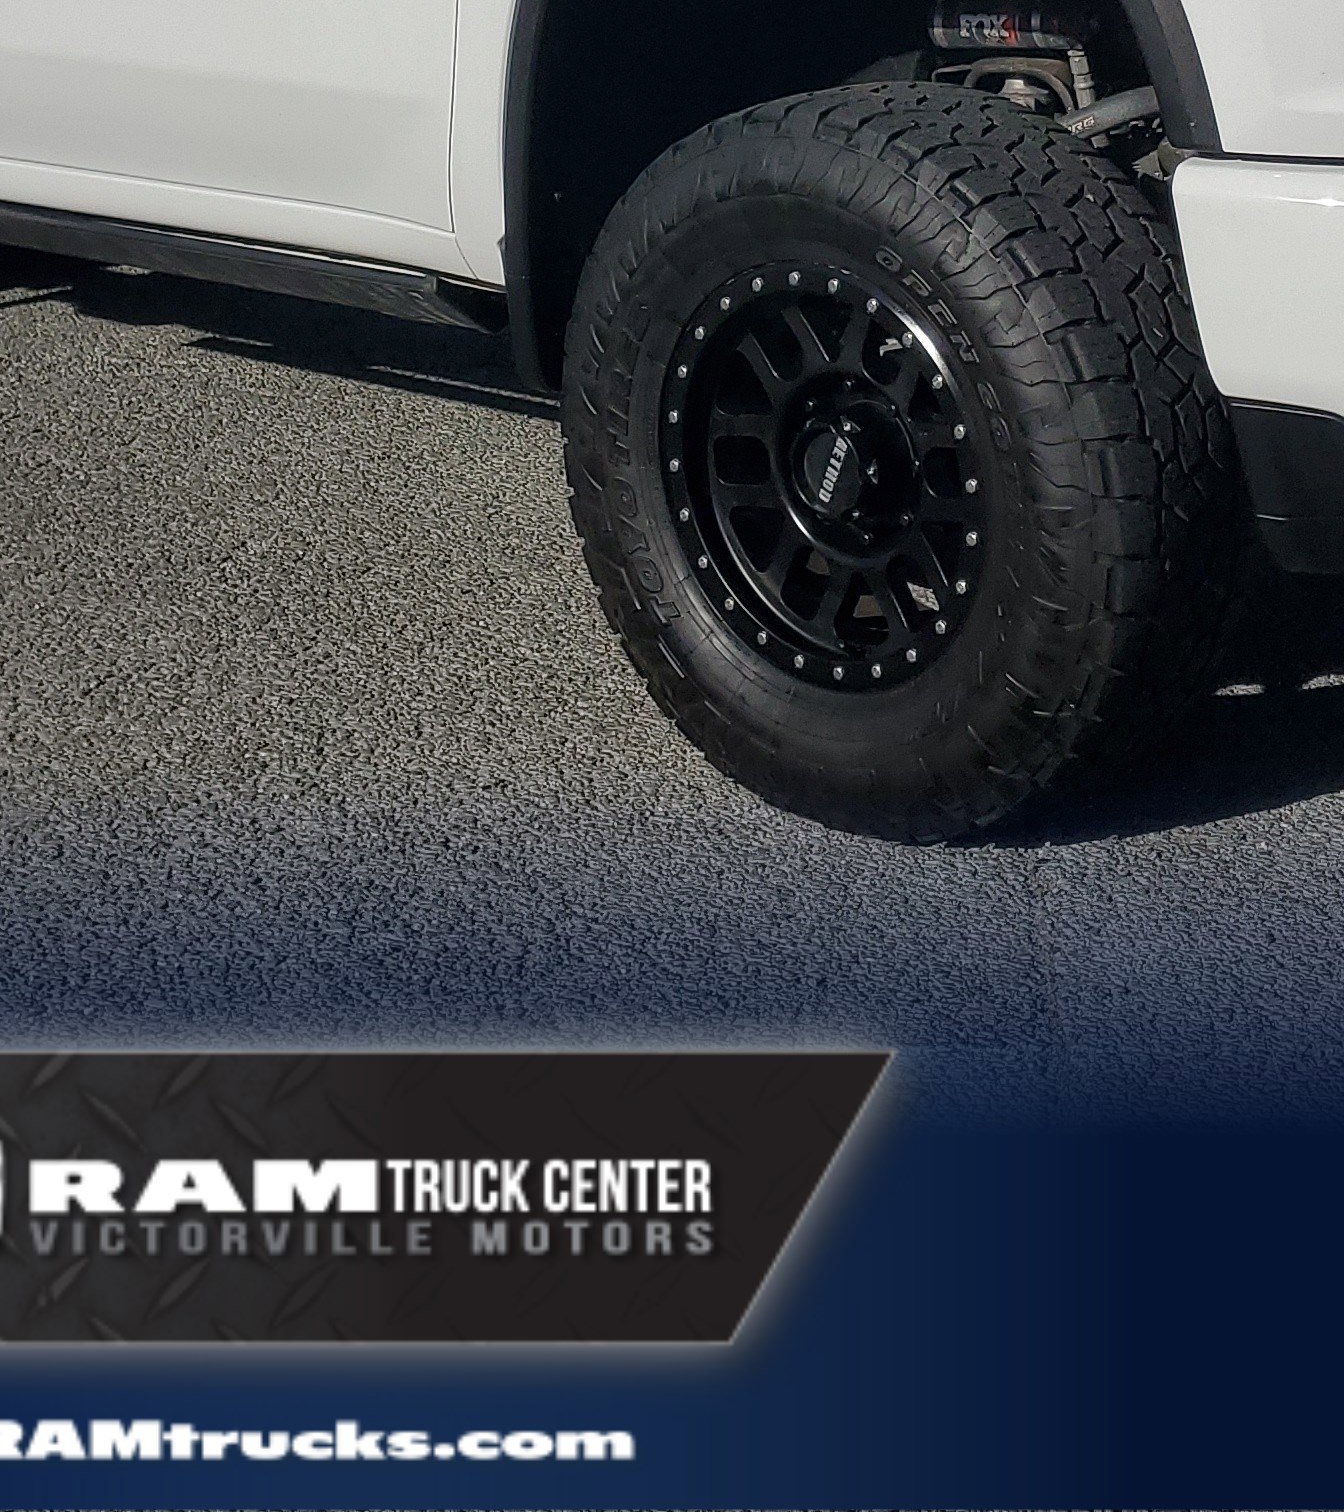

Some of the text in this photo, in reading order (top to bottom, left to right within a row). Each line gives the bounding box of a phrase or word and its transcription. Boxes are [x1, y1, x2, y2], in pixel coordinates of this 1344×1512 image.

[959, 13, 1010, 45] FOX
[875, 245, 980, 363] OPEN
[612, 476, 682, 626] TOYO
